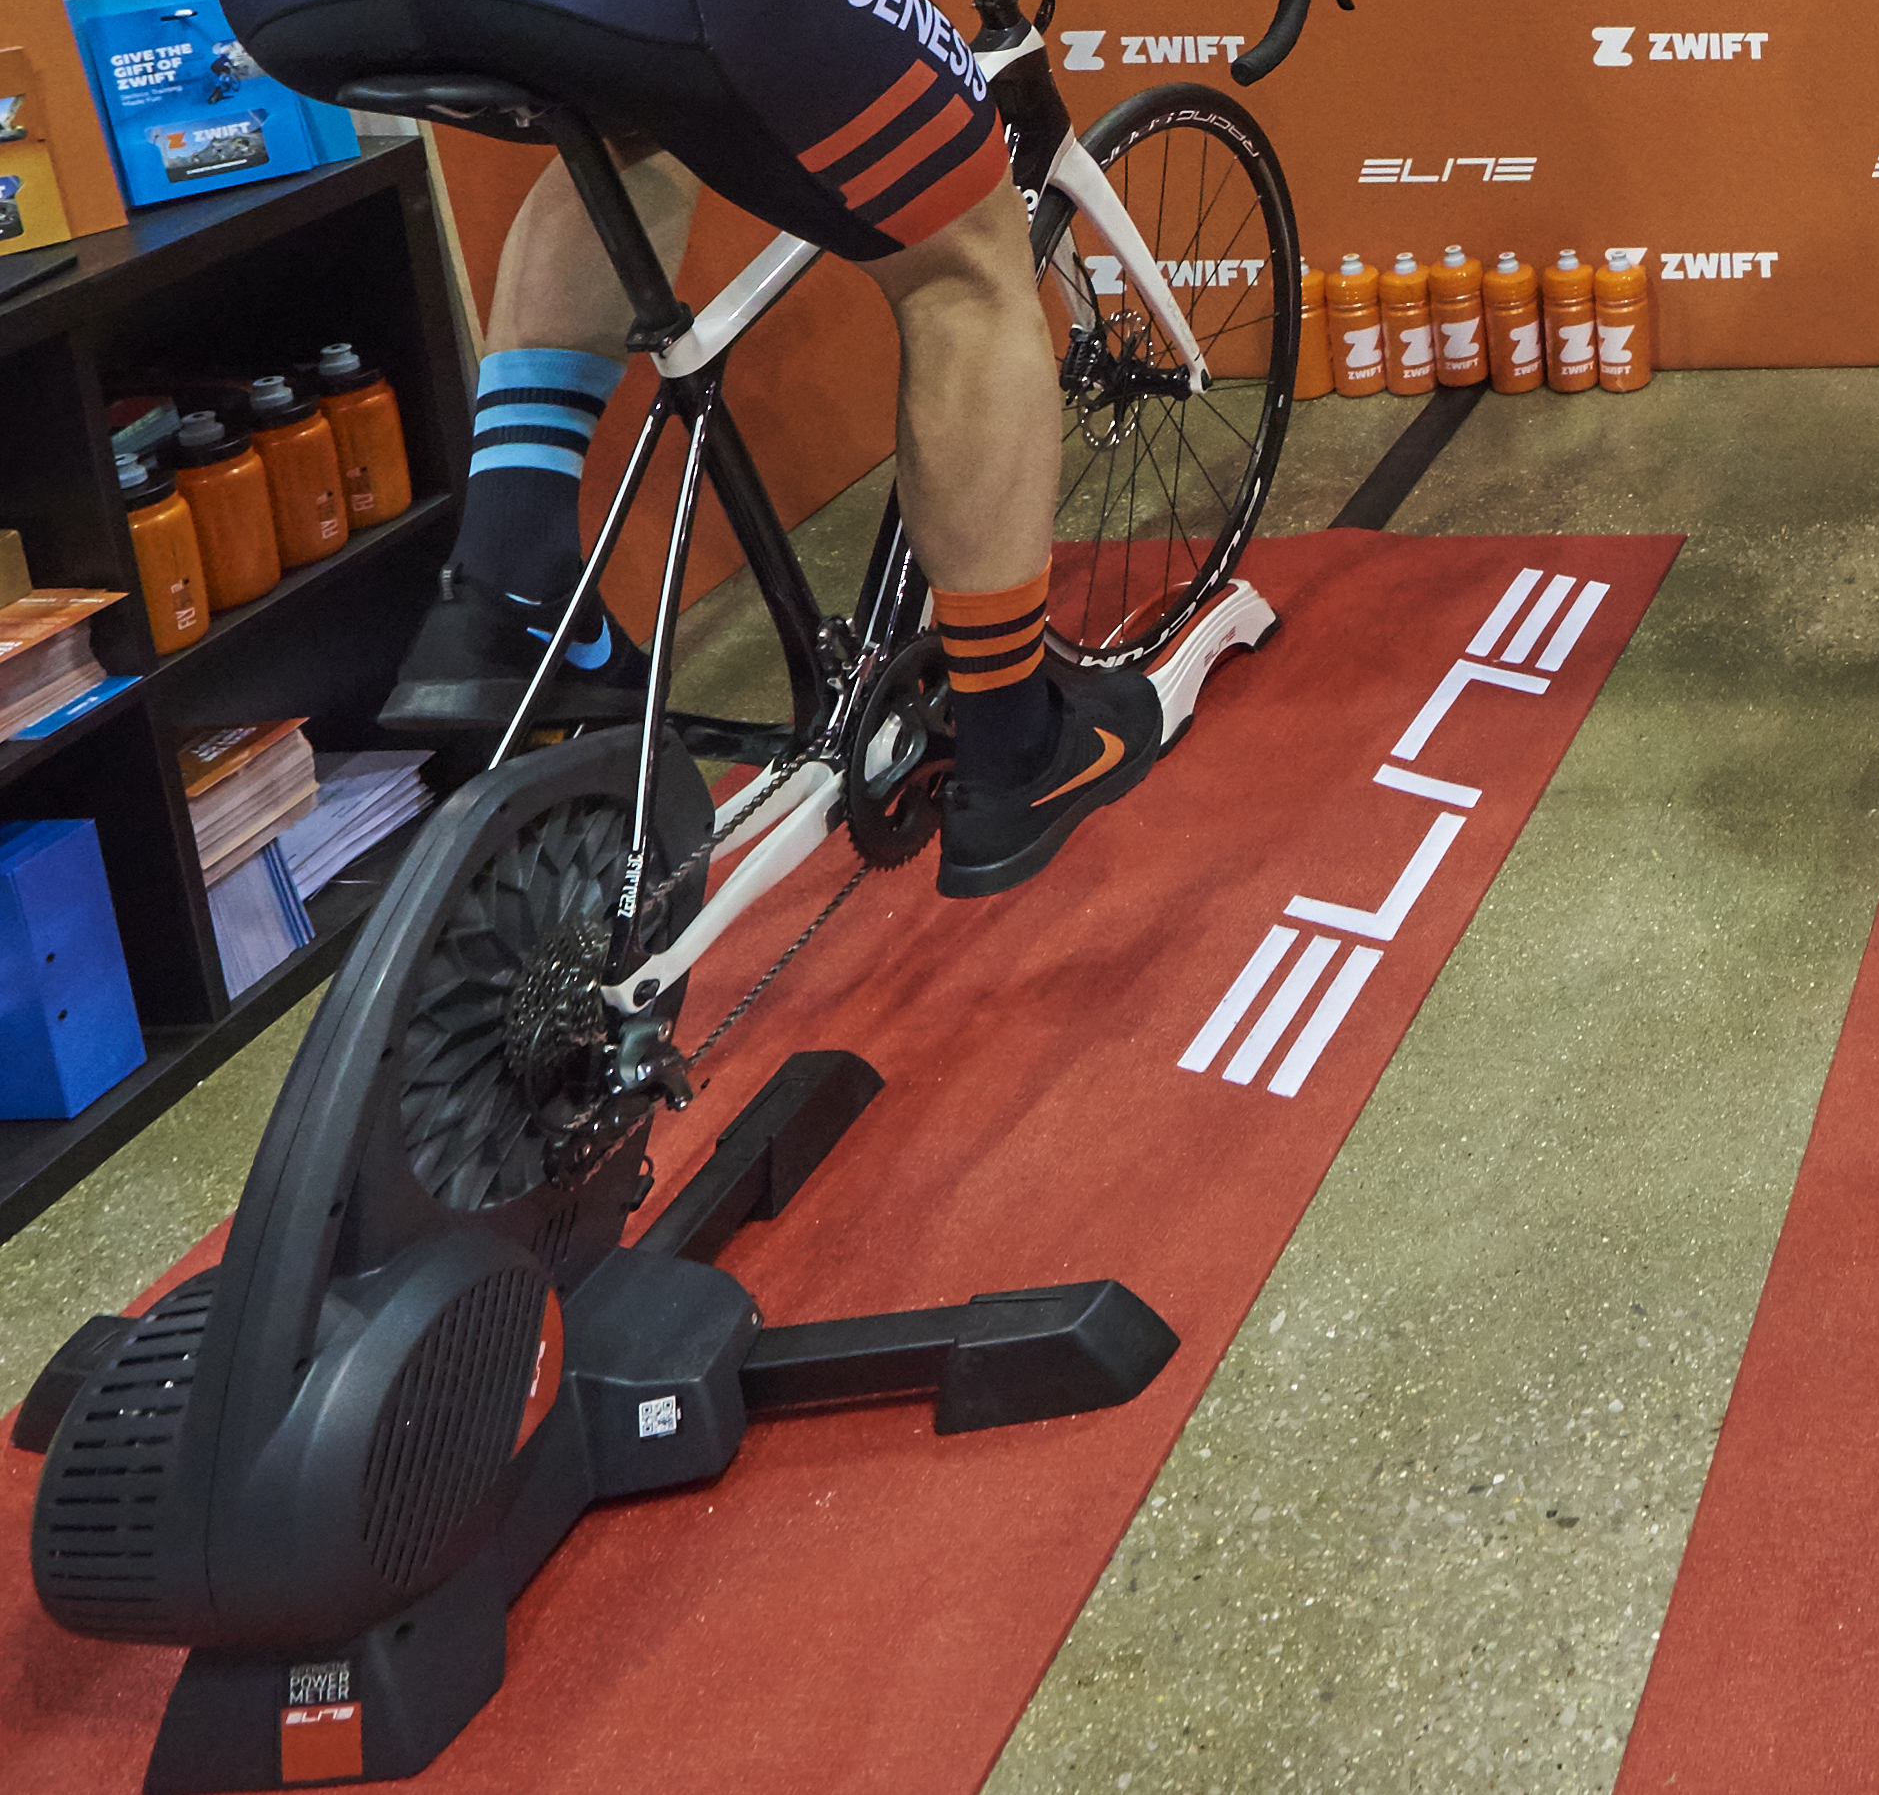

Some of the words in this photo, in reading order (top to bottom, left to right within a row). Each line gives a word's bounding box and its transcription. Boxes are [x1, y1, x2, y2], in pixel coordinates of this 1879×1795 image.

[110, 52, 154, 67] GIVE
[159, 43, 193, 56] THE
[1121, 36, 1245, 63] ZWIFT
[1649, 33, 1768, 60] ZWIFT
[113, 64, 153, 79] GIFT
[156, 58, 183, 71] OF
[116, 71, 176, 91] ZWIFT
[193, 121, 251, 144] ZWIFT
[1359, 158, 1537, 183] ELITE
[1661, 253, 1778, 279] ZWIFT
[1347, 365, 1383, 380] ZWIFT
[1445, 357, 1479, 371] ZWIFT
[1561, 361, 1595, 376] ZWIFT
[290, 1671, 350, 1688] POWER
[289, 1686, 350, 1705] METER
